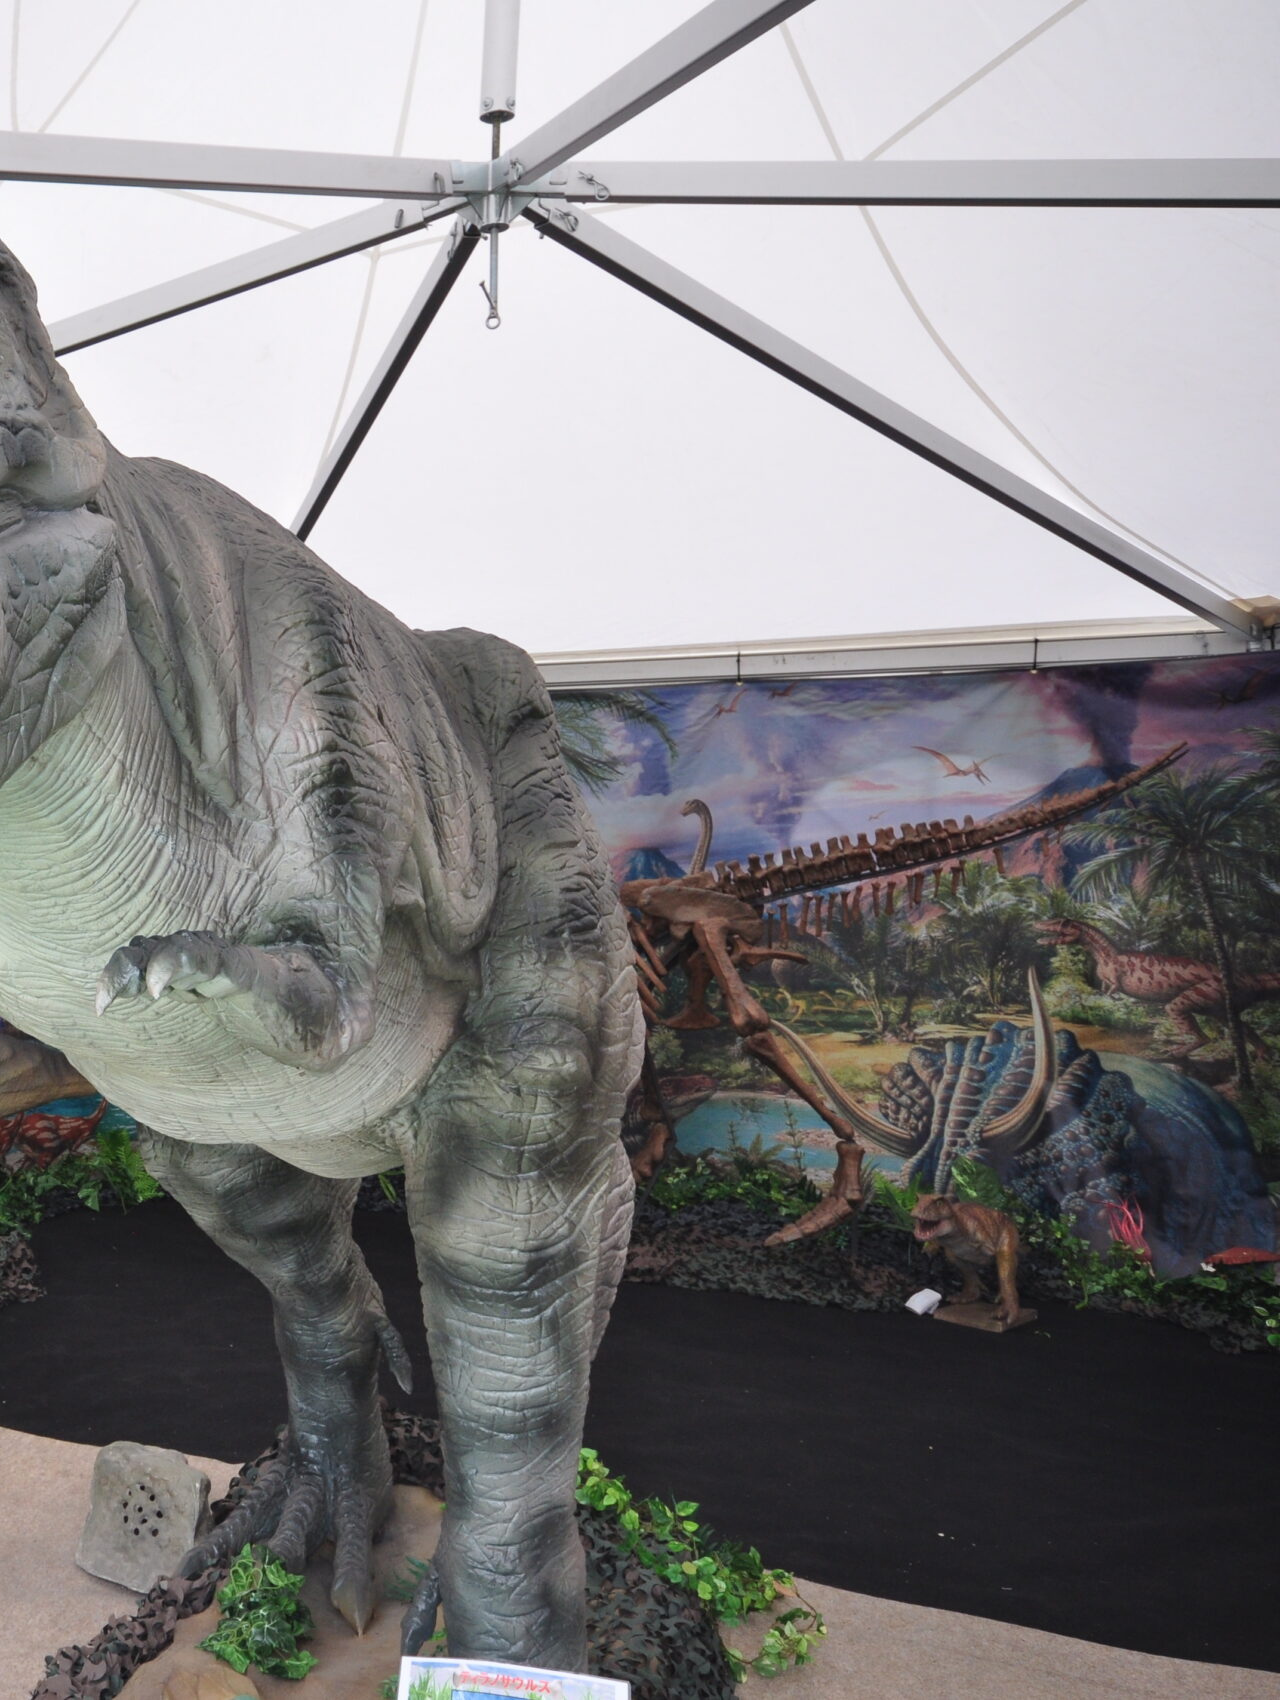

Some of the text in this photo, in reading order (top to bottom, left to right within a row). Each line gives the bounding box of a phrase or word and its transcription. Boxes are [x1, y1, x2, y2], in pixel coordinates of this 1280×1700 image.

[459, 1671, 551, 1694] ティラノサウルス
